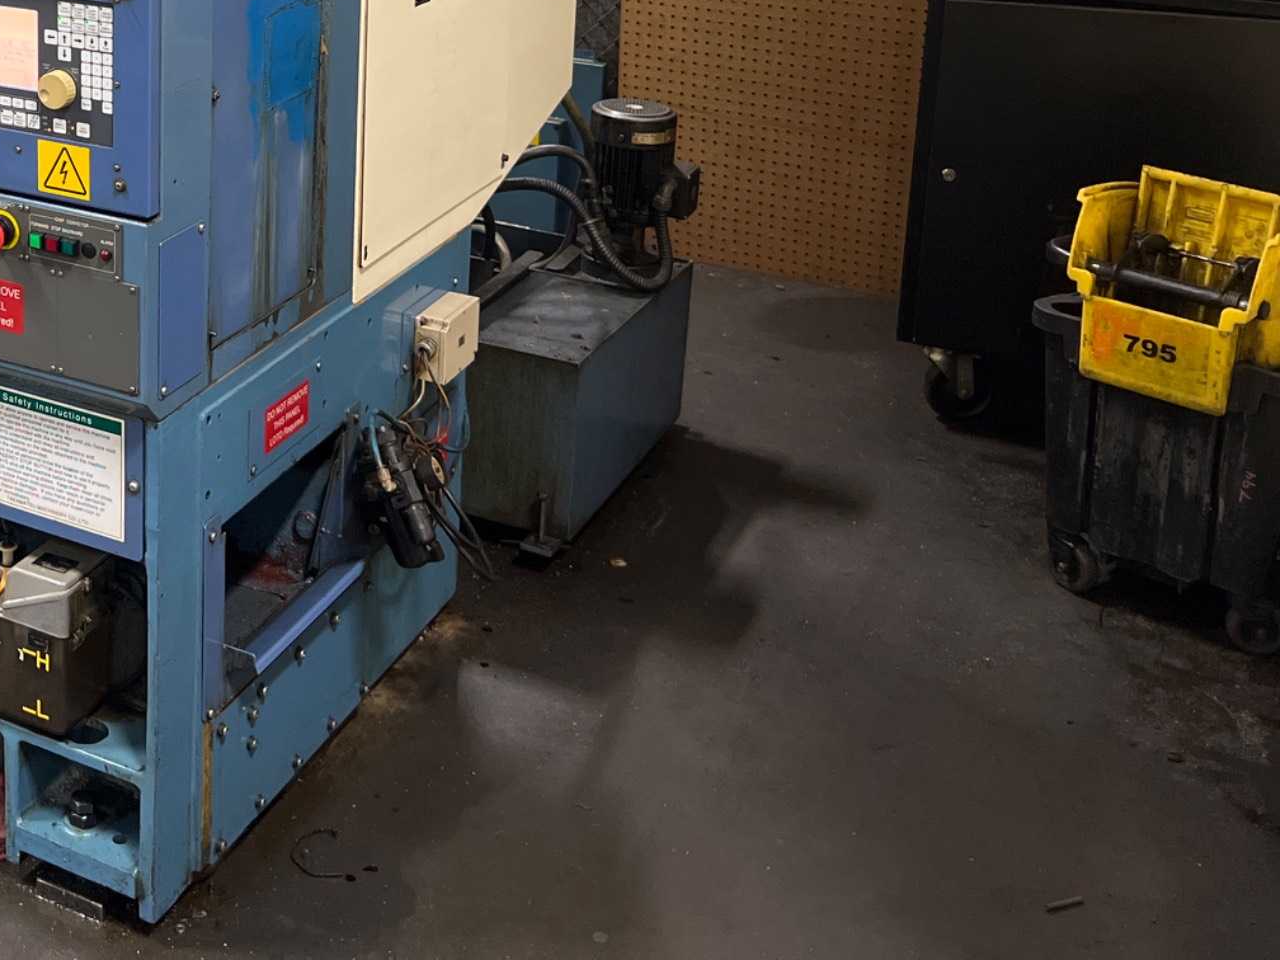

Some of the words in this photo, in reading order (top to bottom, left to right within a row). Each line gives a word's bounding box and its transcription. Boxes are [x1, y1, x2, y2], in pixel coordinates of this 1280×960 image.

[1123, 333, 1178, 364] 795
[1, 392, 32, 410] Safety
[35, 403, 93, 426] Instructions
